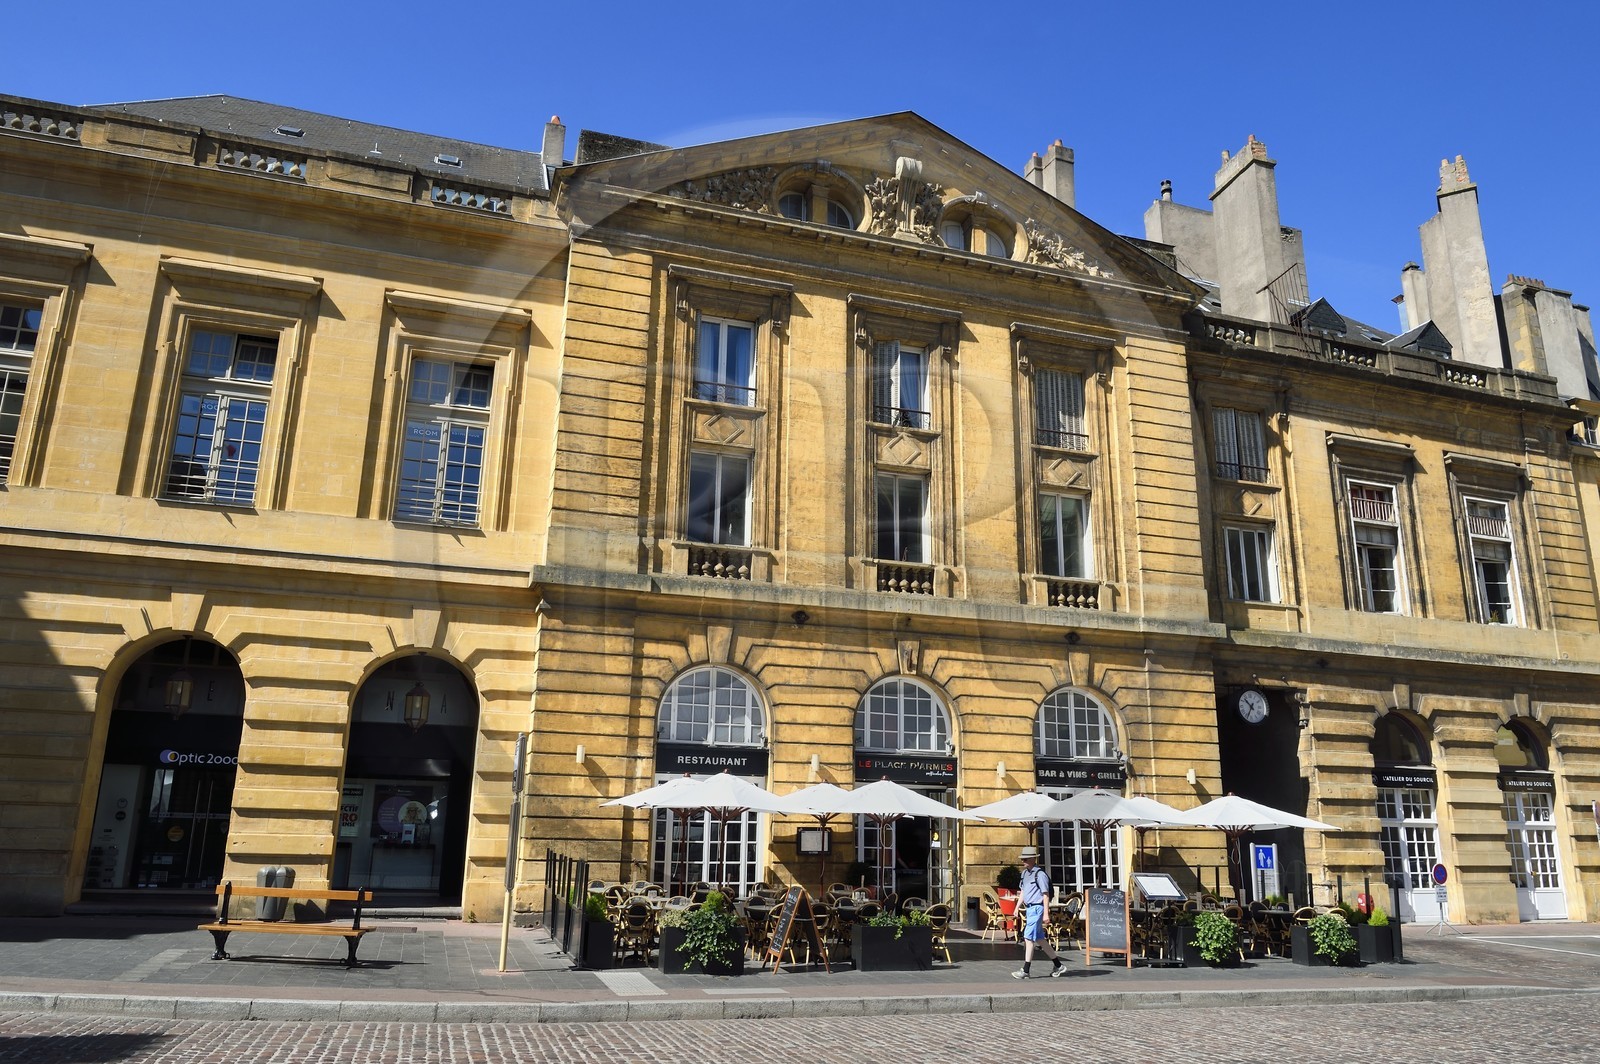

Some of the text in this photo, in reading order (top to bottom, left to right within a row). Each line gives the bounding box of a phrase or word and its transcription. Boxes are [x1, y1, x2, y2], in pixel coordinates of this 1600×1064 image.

[167, 751, 205, 766] Optic
[677, 755, 747, 766] RESTAURANT
[858, 759, 872, 768] LE
[909, 761, 953, 772] D'ARMES
[1038, 769, 1057, 777] BAR
[1067, 770, 1088, 779] VINS
[1097, 772, 1123, 780] GRILL
[1542, 810, 1549, 820] 13
